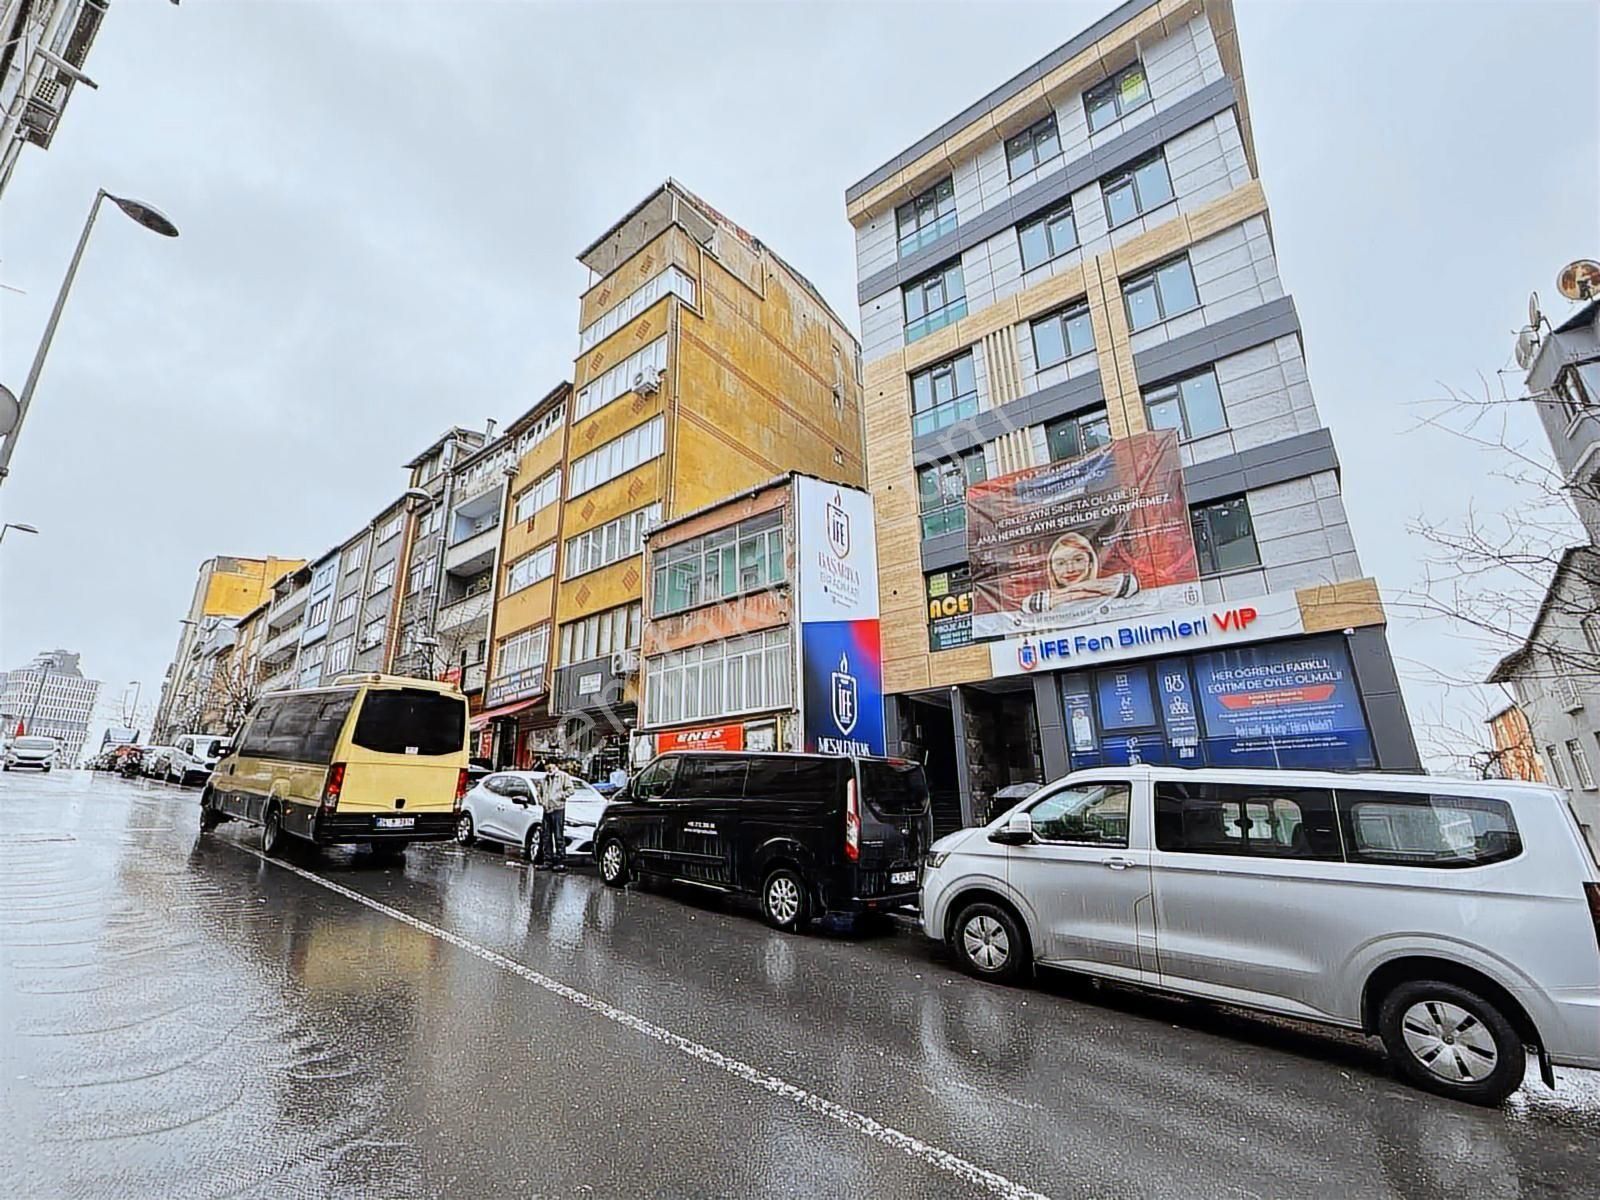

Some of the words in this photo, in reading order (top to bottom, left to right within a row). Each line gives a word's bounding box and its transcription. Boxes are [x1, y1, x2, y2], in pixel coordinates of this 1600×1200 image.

[1030, 509, 1051, 521] AYNI
[977, 532, 998, 547] AMA
[998, 526, 1032, 543] HERKES
[1033, 519, 1056, 534] AYNI
[1057, 511, 1099, 533] ŞEKİLDE
[1039, 639, 1070, 660] İFE
[1075, 635, 1114, 654] Fen
[1118, 616, 1208, 646] Bilimleri
[1213, 607, 1257, 632] VIP
[1212, 670, 1233, 681] HER
[1247, 679, 1262, 689] DE
